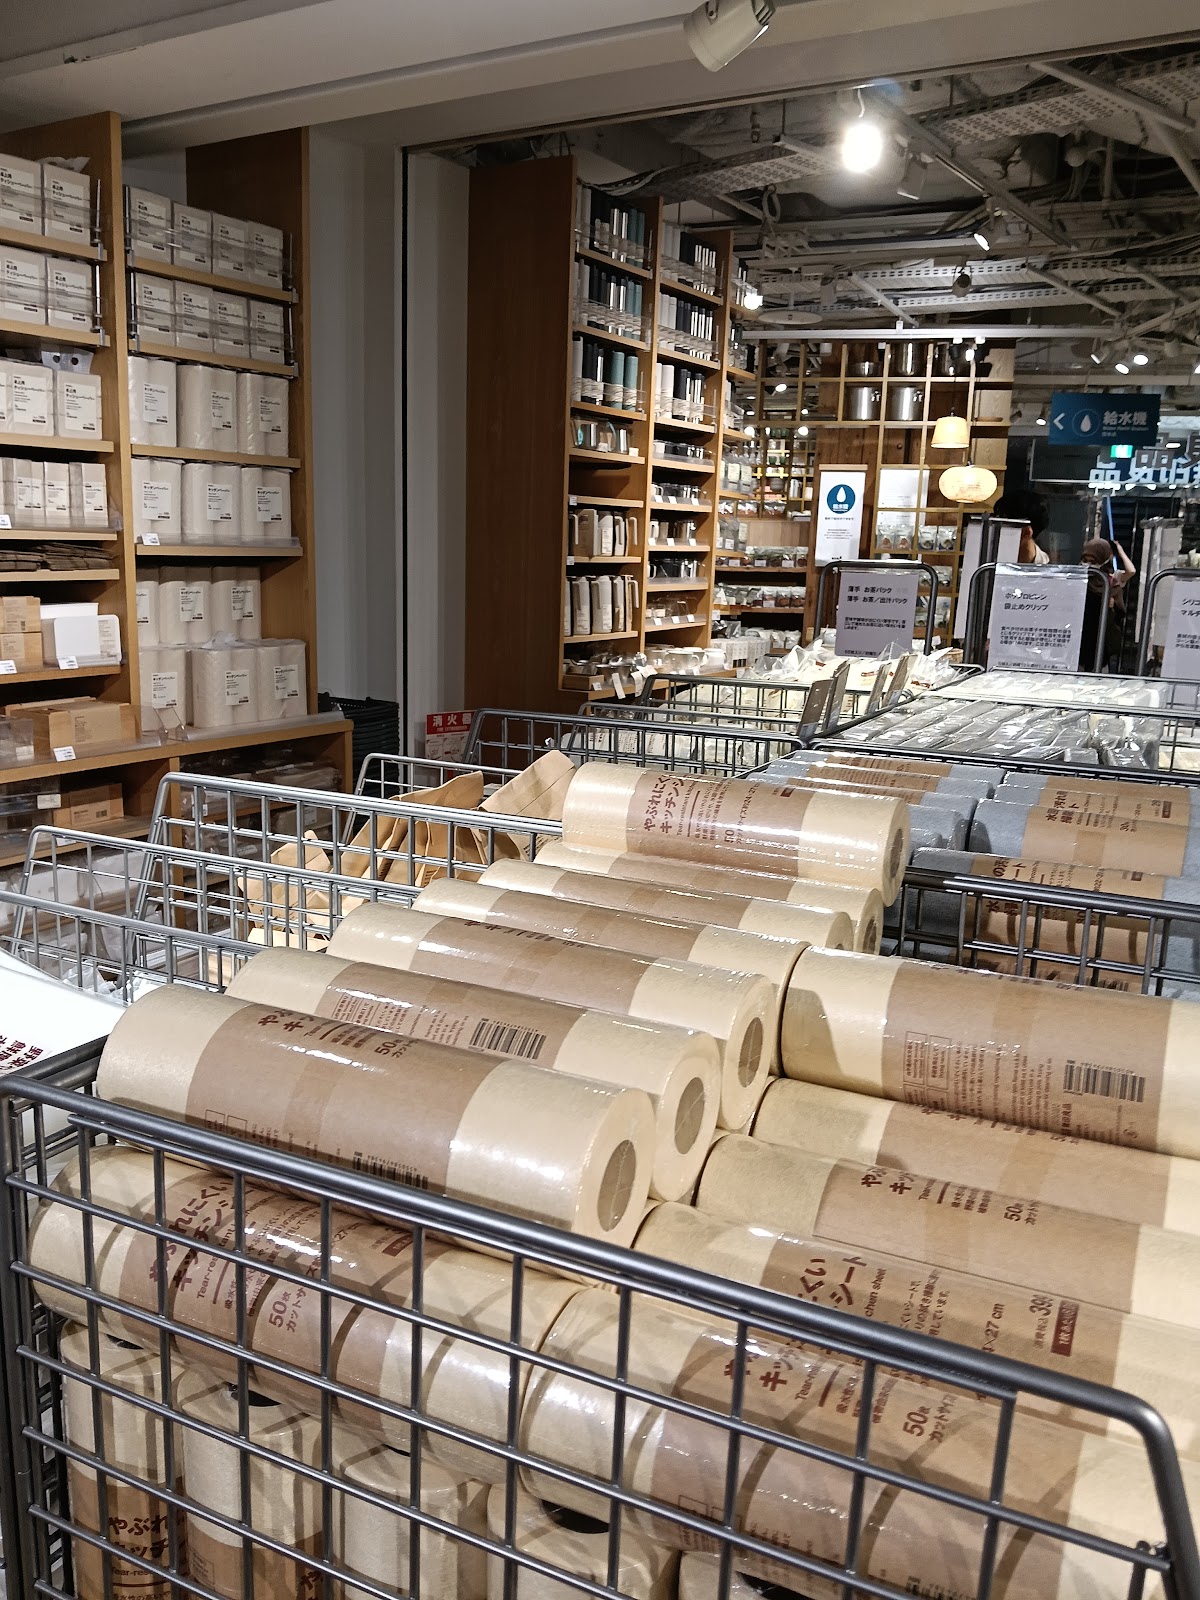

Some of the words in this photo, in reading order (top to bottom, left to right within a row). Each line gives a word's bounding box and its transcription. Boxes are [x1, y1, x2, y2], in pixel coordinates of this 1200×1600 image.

[1103, 410, 1148, 426] 給水機
[1004, 602, 1049, 611] 袋止めクリップ
[432, 712, 472, 727] 消火器
[196, 1228, 235, 1299] Tear-restant
[267, 1290, 296, 1328] 50枚
[901, 1402, 931, 1438] 50枚
